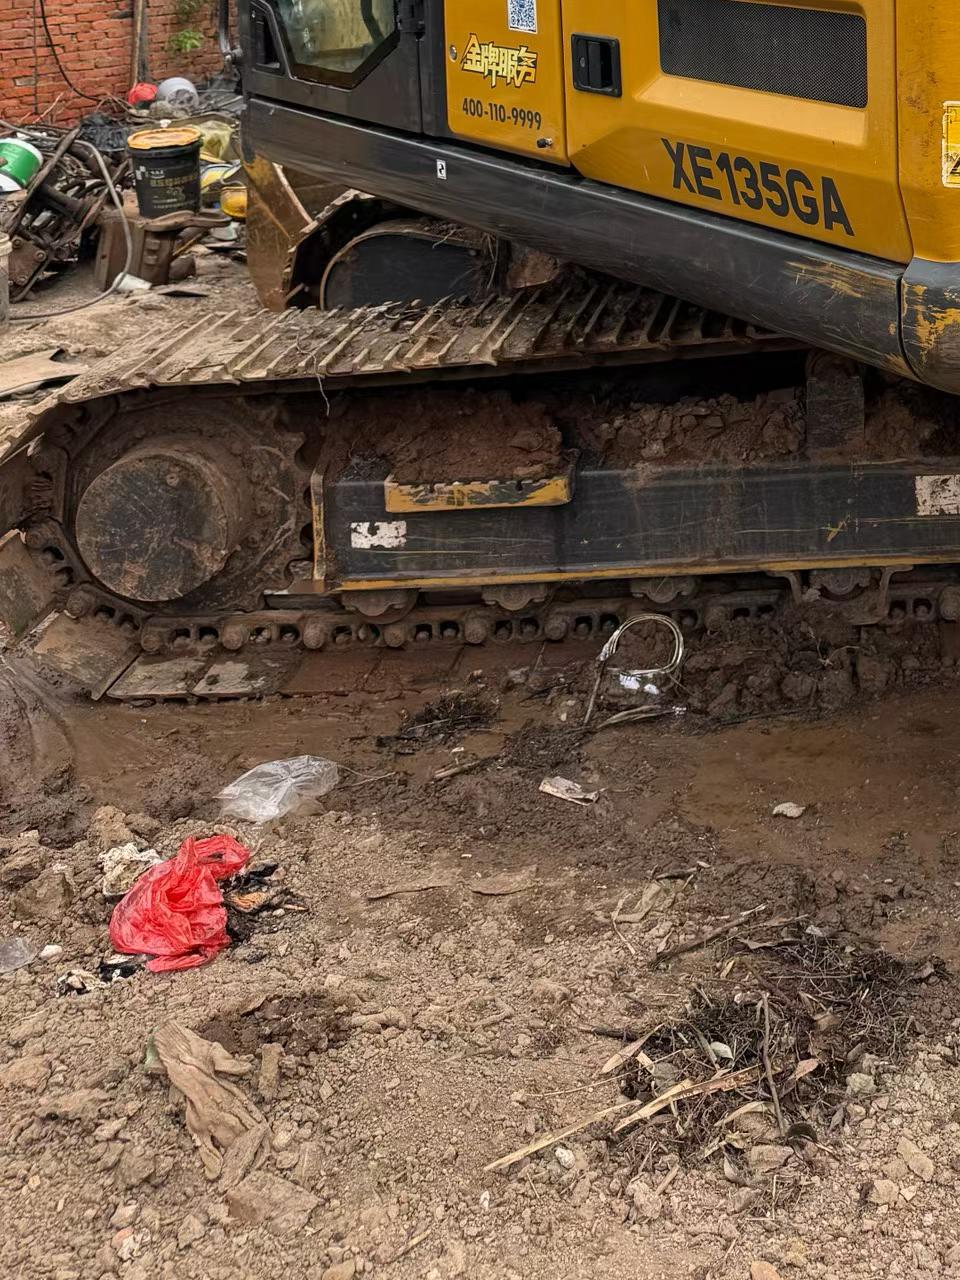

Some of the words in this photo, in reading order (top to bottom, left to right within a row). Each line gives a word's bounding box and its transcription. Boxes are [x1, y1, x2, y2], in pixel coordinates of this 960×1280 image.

[460, 32, 538, 88] 金牌服务
[462, 97, 542, 131] 400-110-9999
[660, 137, 855, 238] XE135GA
